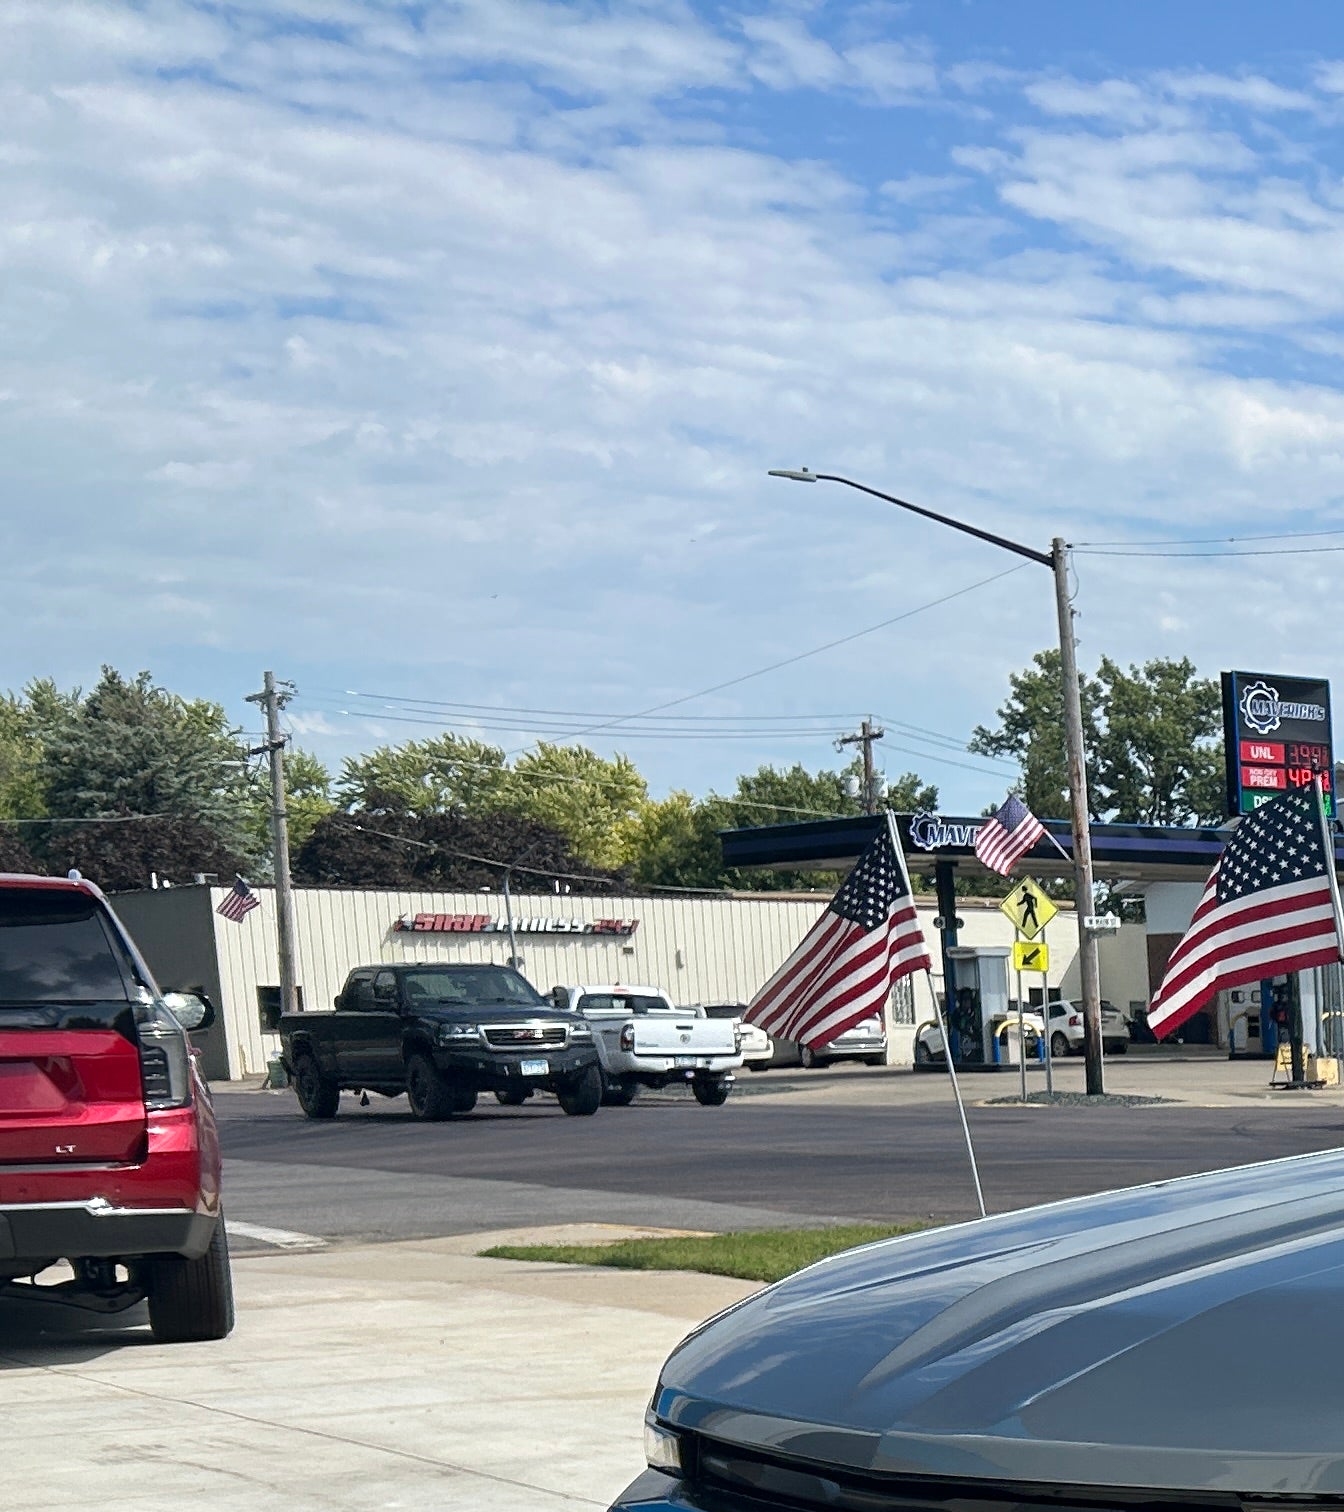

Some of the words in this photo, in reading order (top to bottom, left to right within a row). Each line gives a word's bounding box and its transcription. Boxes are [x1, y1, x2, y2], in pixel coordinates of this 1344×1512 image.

[1250, 745, 1275, 760] UNL
[1250, 775, 1278, 787] PREM
[1253, 795, 1273, 809] DS
[55, 1145, 77, 1154] LT
